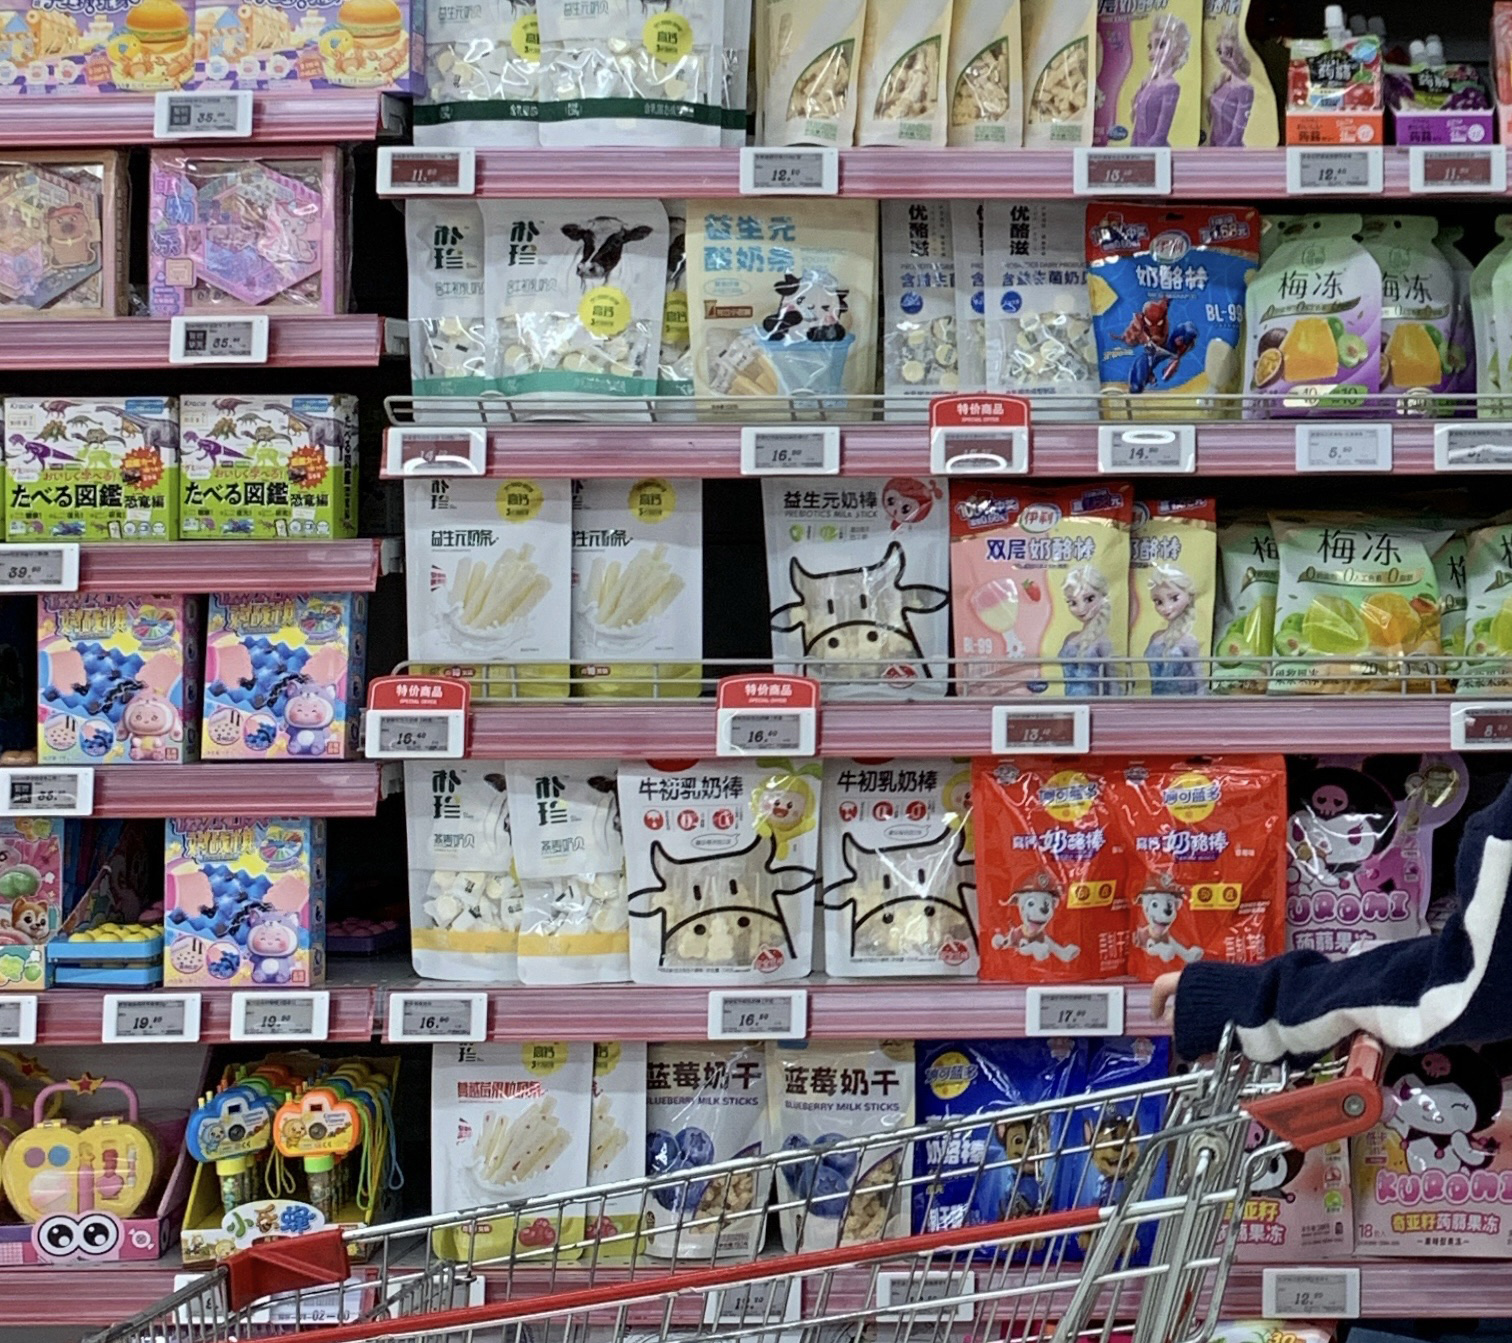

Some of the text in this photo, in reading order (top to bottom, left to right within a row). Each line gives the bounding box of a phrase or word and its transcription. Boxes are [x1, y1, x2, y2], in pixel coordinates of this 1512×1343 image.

[1009, 205, 1031, 256] 优酪滋
[1278, 270, 1344, 300] 梅冻
[957, 403, 1005, 416] 特价商品
[11, 484, 123, 509] たべる図鑑
[185, 482, 288, 507] たべる図鑑
[784, 490, 878, 509] 益生元奶棒
[1024, 511, 1055, 527] 伊利
[986, 537, 1096, 561] 双层奶酪棒
[1317, 528, 1402, 565] 梅冻
[396, 684, 444, 698] 特价商品
[745, 683, 793, 697] 特价商品
[638, 776, 743, 801] 牛初乳奶棒
[837, 770, 938, 793] 牛初乳奶棒
[1287, 892, 1410, 923] UROMI
[647, 1060, 762, 1092] 蓝莓奶干
[784, 1067, 901, 1097] 蓝莓奶干
[726, 1096, 760, 1107] STICKS
[785, 1100, 900, 1113] BLUEBERRY MILK STICKS
[1391, 1211, 1501, 1235] 奇亚籽蒟蒻果冻
